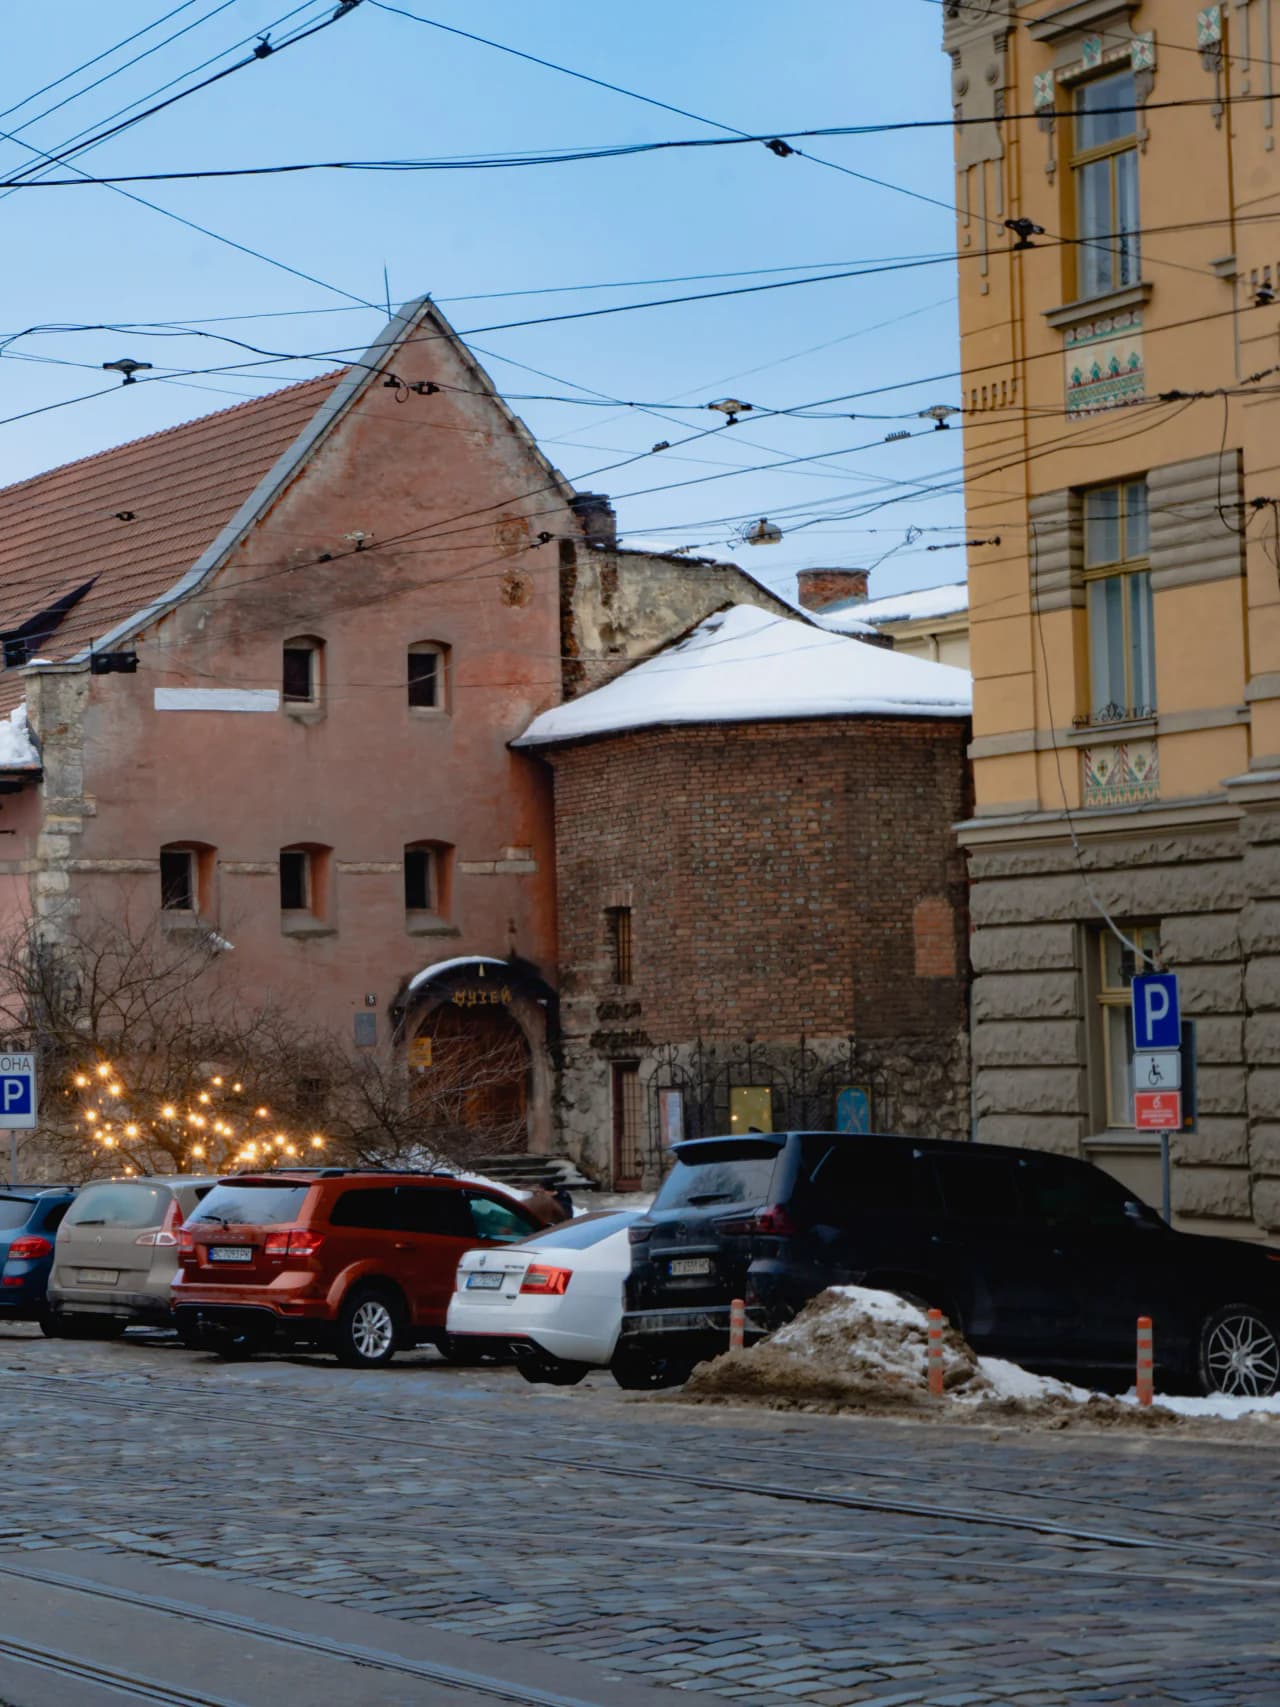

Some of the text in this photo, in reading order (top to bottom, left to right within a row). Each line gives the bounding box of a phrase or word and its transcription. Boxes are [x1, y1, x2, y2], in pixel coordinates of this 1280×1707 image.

[453, 984, 512, 1008] МУЗЕЙ
[1144, 984, 1169, 1041] P
[3, 1079, 24, 1112] P
